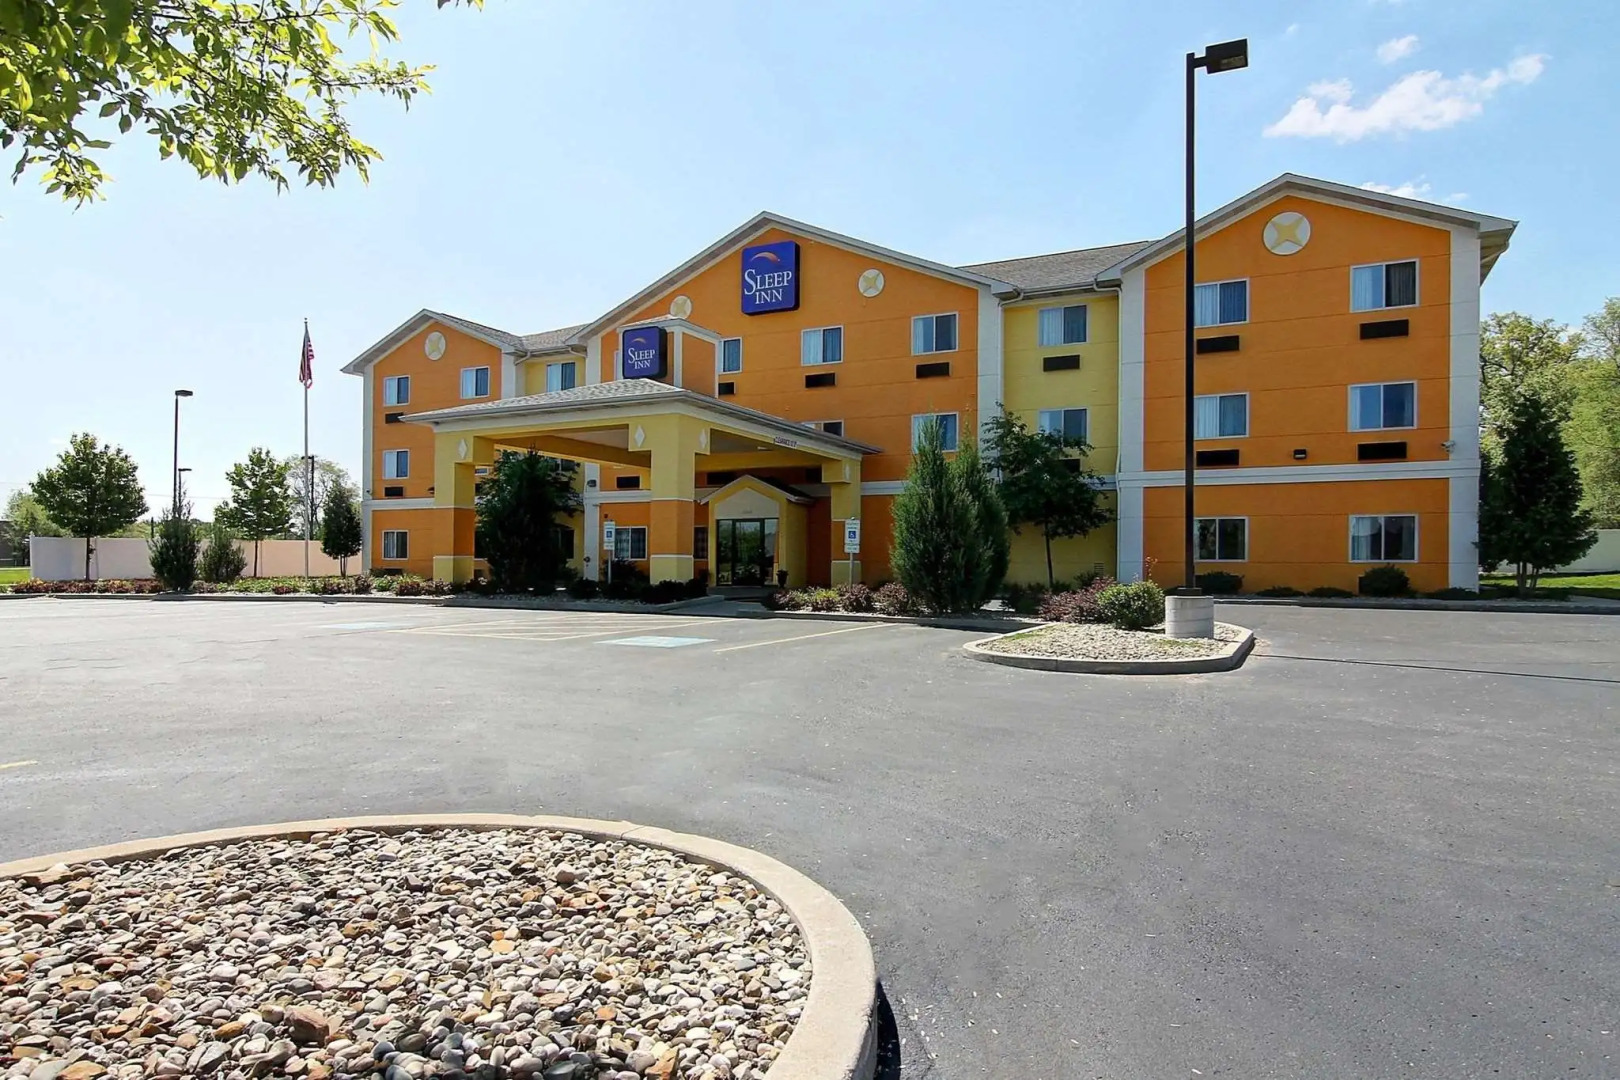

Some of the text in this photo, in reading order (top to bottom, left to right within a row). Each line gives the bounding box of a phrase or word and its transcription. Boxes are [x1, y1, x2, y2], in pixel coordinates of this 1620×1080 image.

[744, 268, 792, 295] SLEEP
[755, 288, 783, 304] INN
[628, 347, 656, 364] SLEEP
[634, 359, 651, 370] INN
